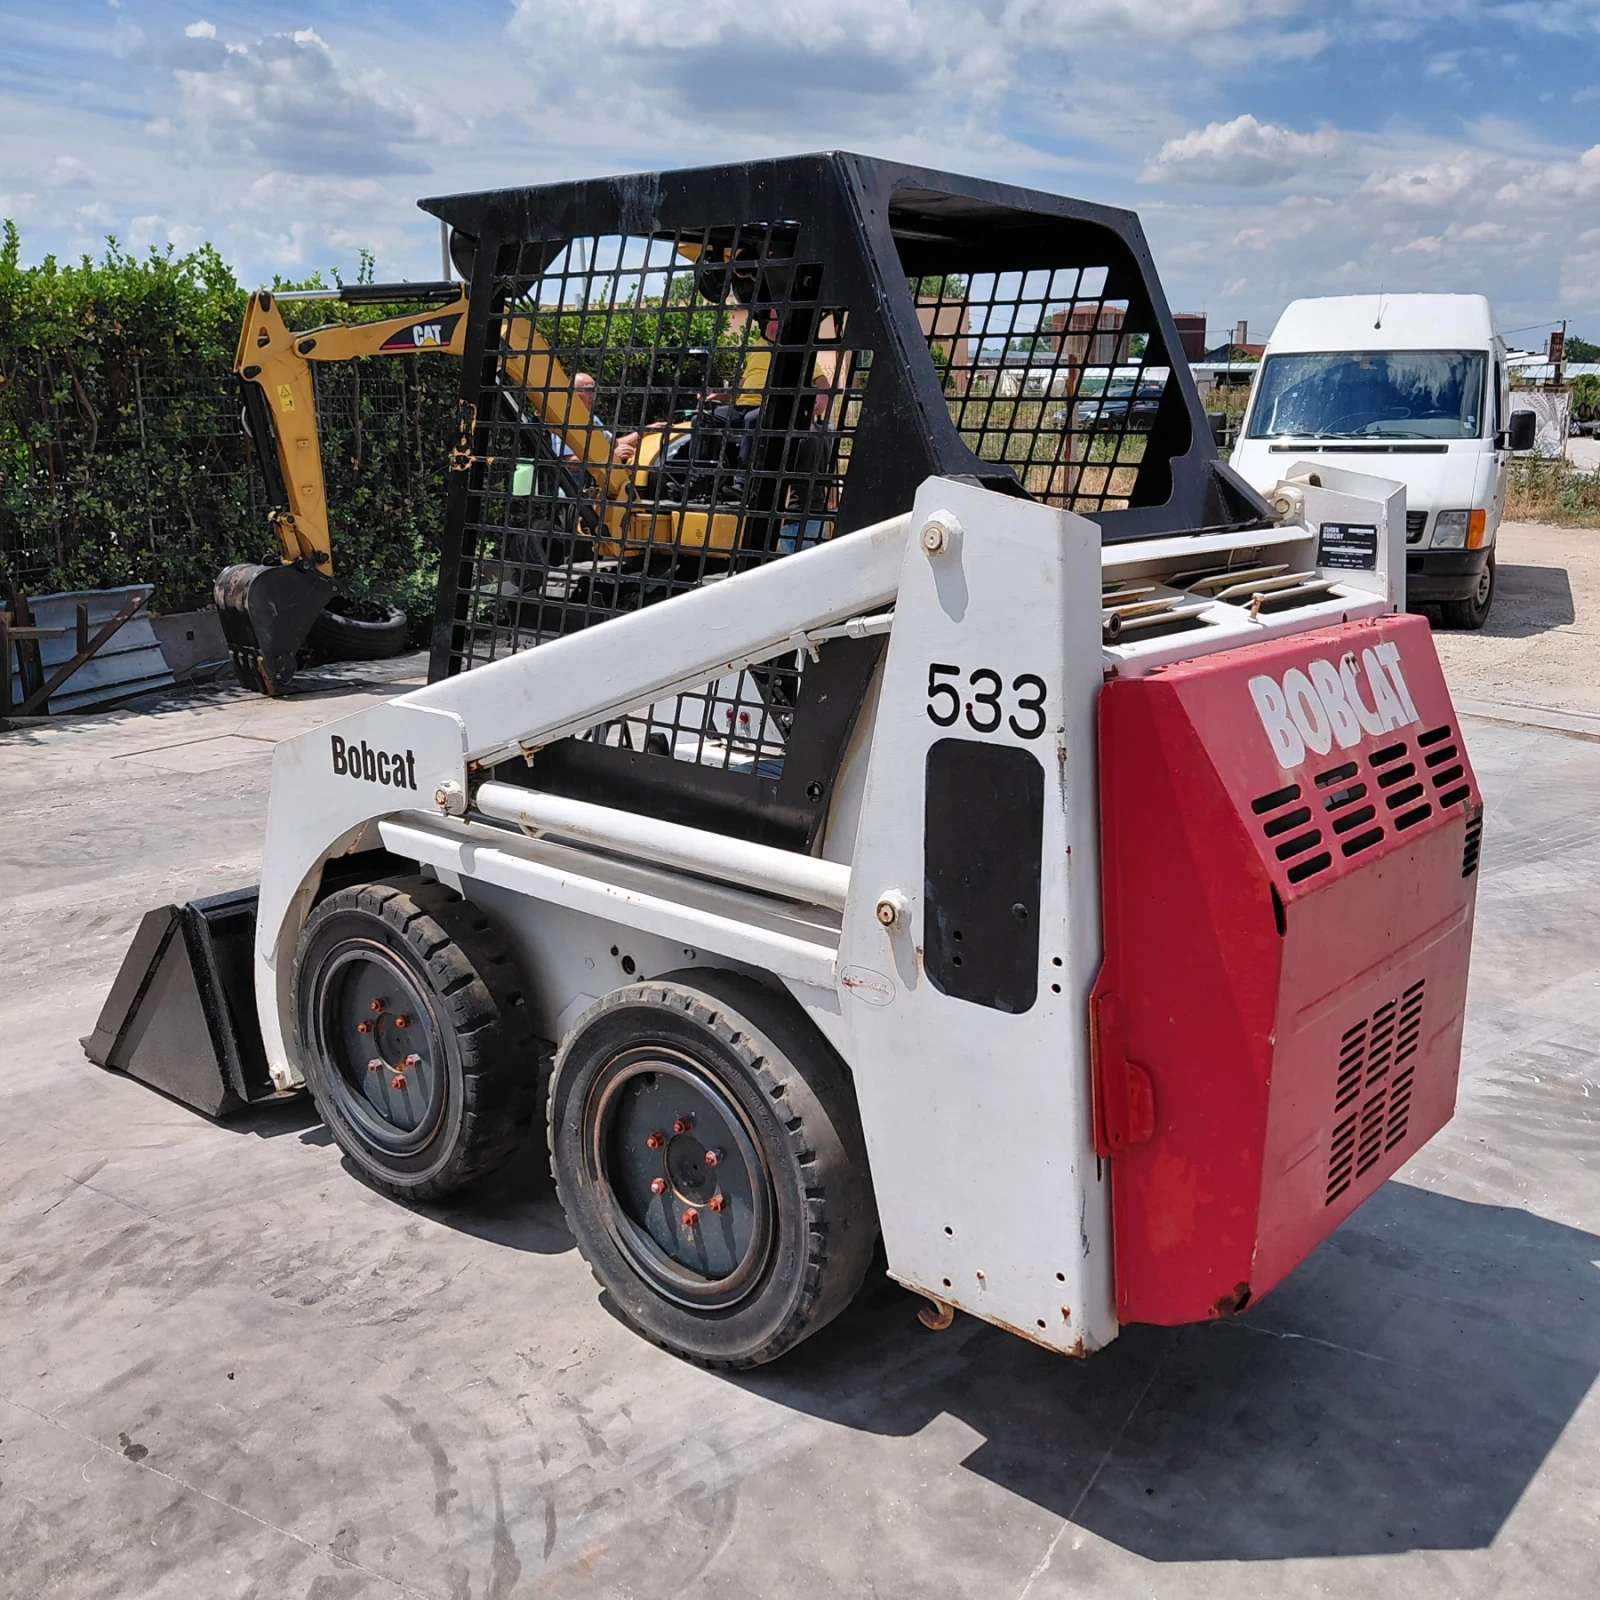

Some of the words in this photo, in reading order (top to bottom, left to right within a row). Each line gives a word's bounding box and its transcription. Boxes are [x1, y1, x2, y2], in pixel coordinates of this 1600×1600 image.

[413, 325, 442, 347] CAT
[927, 663, 1047, 740] 533
[1248, 641, 1419, 769] BOBCAT
[331, 735, 417, 791] Bobcat
